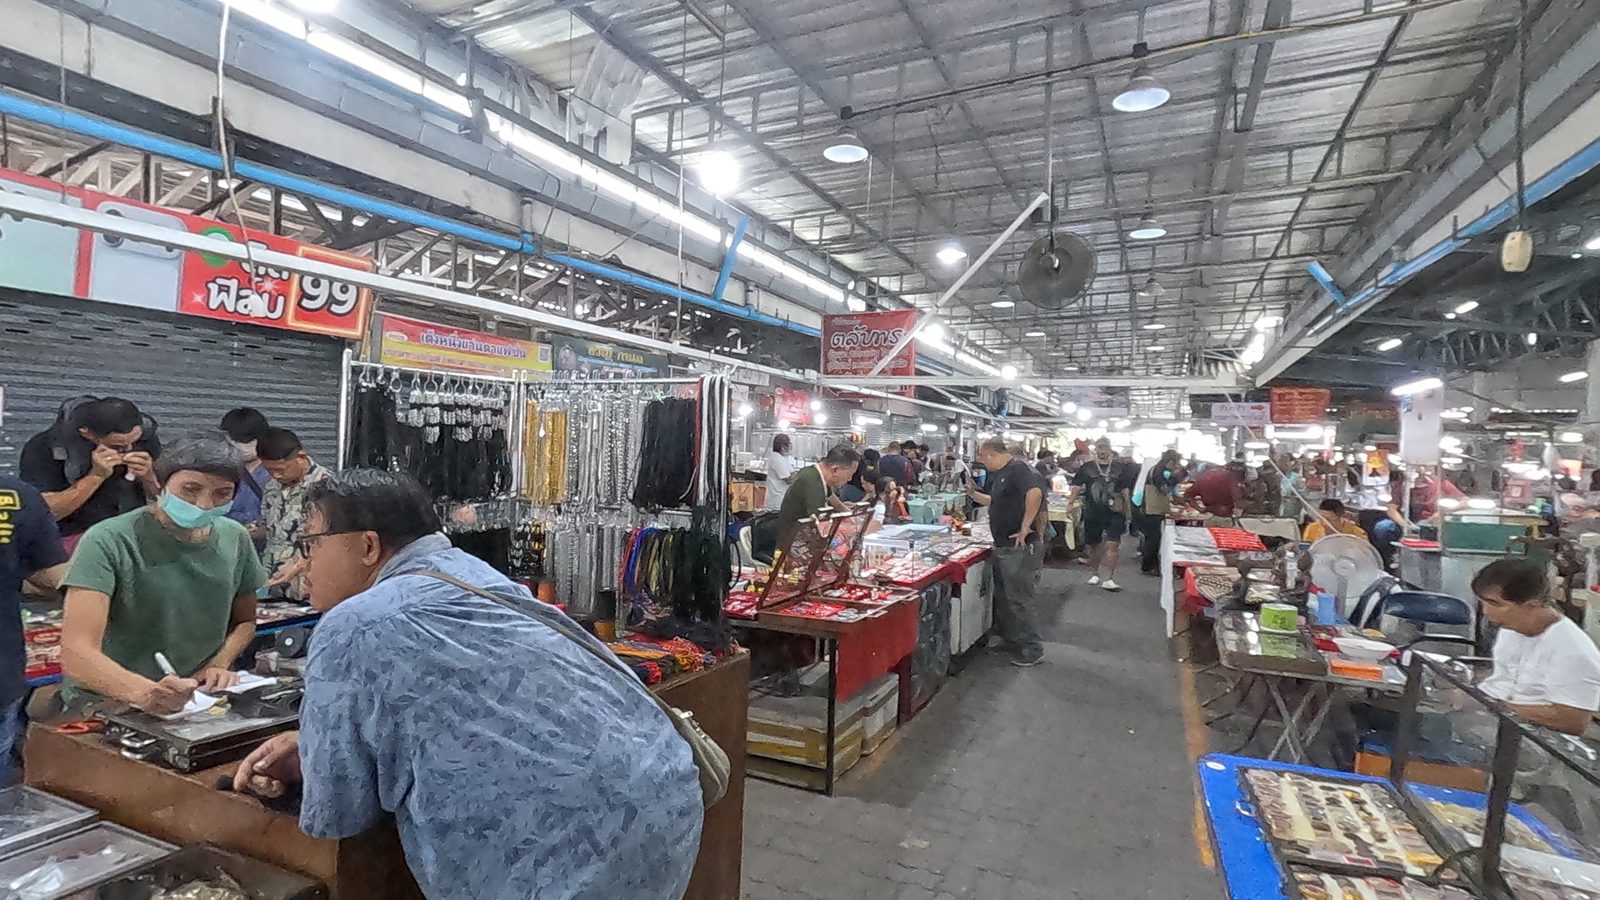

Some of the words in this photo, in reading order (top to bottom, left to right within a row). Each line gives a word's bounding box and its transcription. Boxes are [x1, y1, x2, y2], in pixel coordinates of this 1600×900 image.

[299, 274, 358, 316] 99
[831, 324, 910, 349] ตลับพร
